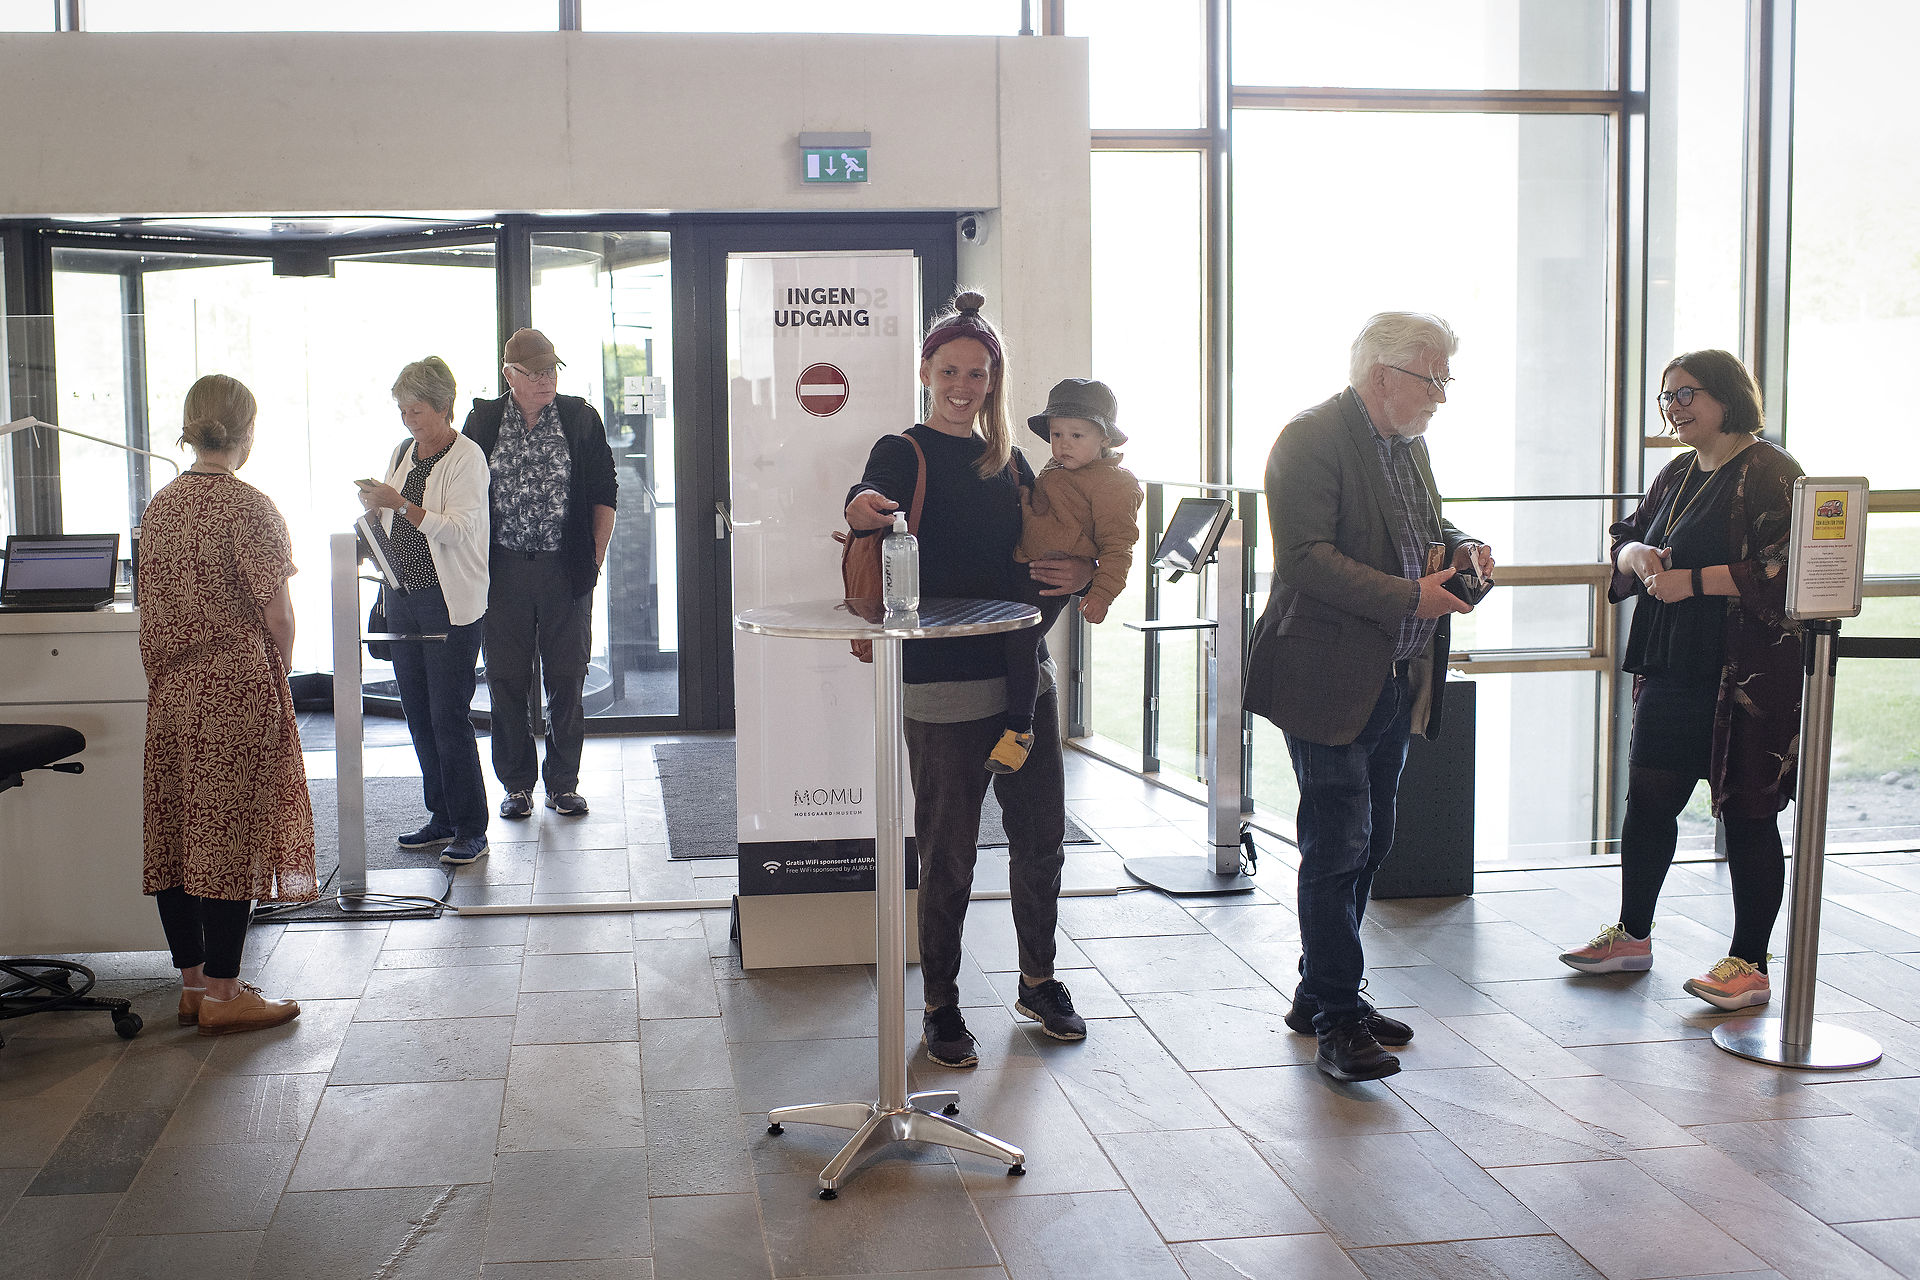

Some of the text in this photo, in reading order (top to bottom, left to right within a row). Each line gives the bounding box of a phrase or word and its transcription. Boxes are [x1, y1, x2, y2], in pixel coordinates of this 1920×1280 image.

[787, 287, 855, 305] INGEN
[774, 309, 870, 327] UDGANG
[793, 787, 863, 806] MOMU
[812, 865, 843, 874] sponsored
[843, 865, 851, 873] by
[819, 858, 850, 866] sponseret
